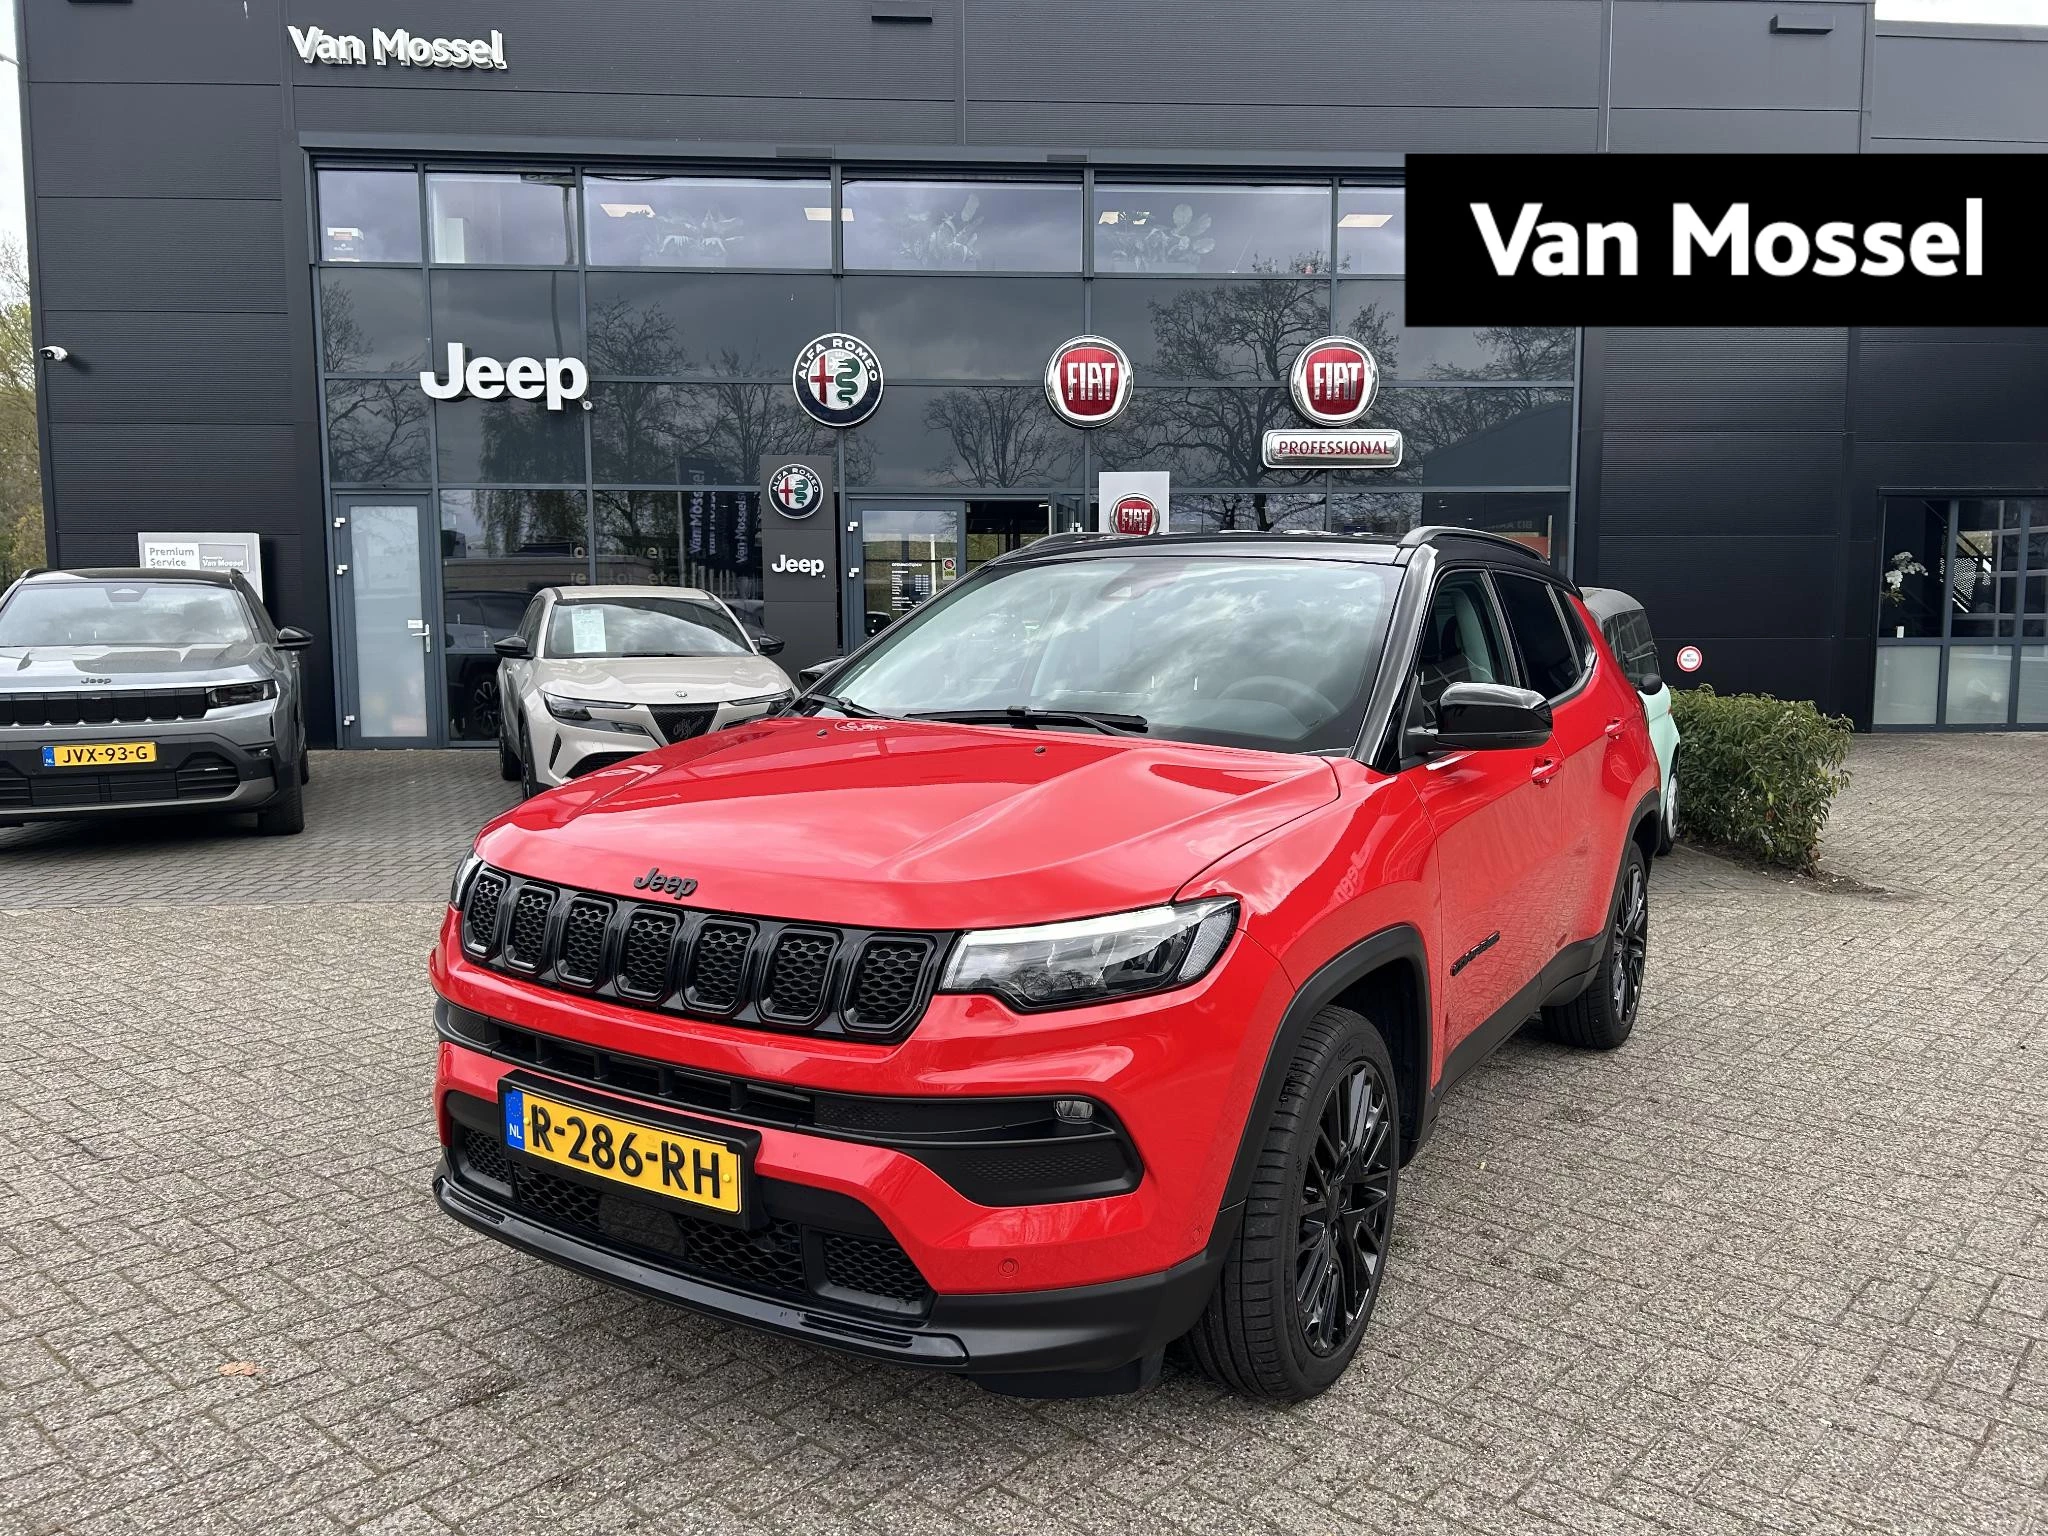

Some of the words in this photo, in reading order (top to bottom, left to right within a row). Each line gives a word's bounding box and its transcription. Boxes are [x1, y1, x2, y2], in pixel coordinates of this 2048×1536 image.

[287, 26, 367, 65] Van
[372, 28, 508, 70] Mossel
[798, 343, 827, 380] ALFA
[832, 338, 878, 382] ROMEO
[420, 342, 588, 411] Jeep
[1067, 362, 1116, 401] FIAT
[1313, 362, 1362, 401] FIAT
[1278, 440, 1392, 455] PROFESSIONAL
[772, 470, 789, 492] ALFA
[791, 467, 819, 493] ROMEO
[1121, 508, 1151, 532] FIAT
[149, 547, 195, 556] Premium
[688, 527, 703, 555] Van
[735, 543, 748, 564] Van
[150, 558, 187, 567] Service
[202, 559, 217, 567] Van
[218, 559, 244, 567] Mossel
[771, 554, 825, 577] Jeep
[80, 677, 112, 685] Jeep
[62, 745, 148, 764] JVX-93-G
[633, 867, 698, 900] Jeep
[509, 1123, 523, 1140] NL
[531, 1103, 721, 1199] R-286-RH
